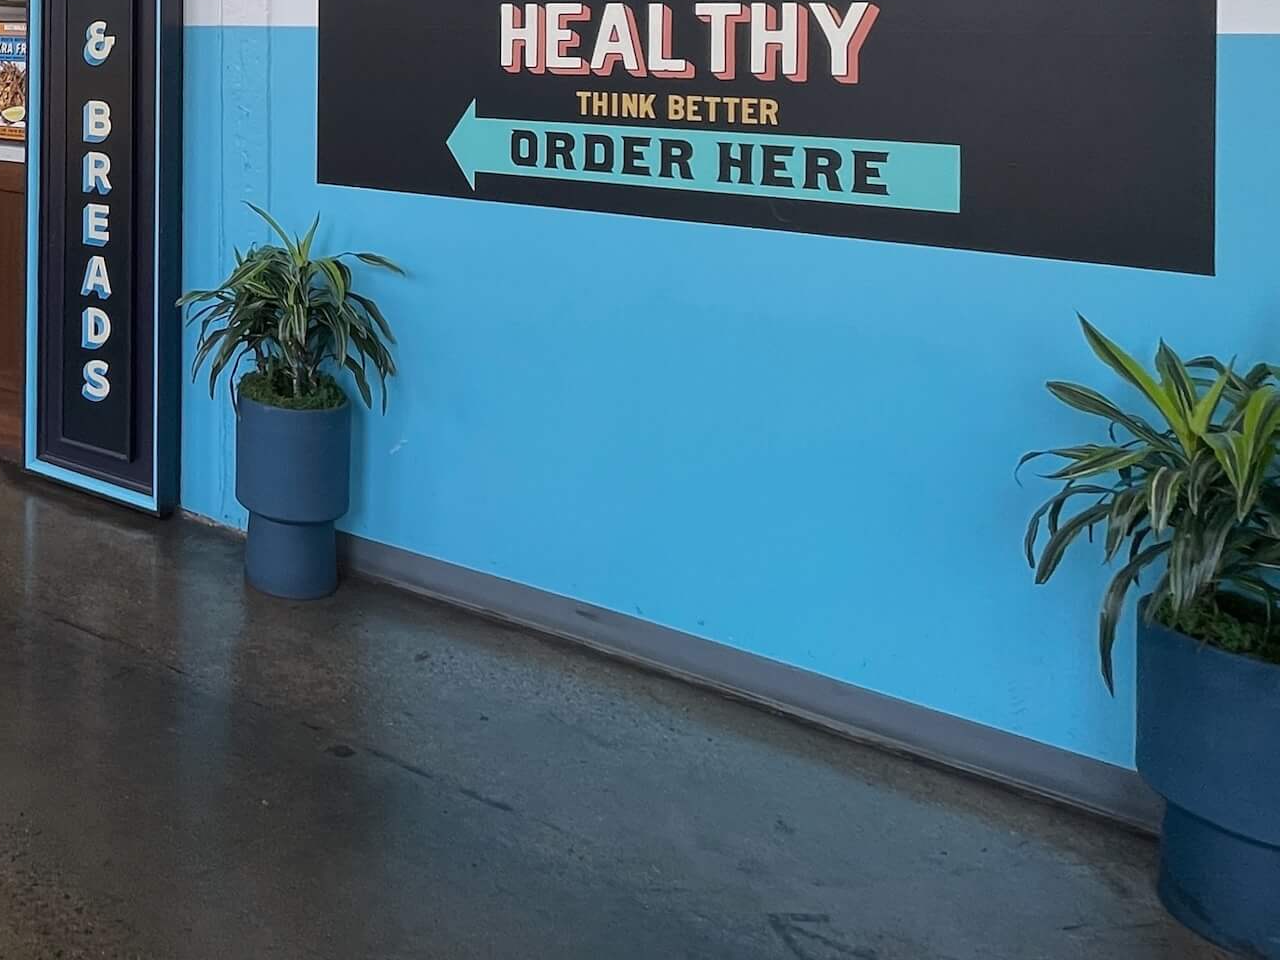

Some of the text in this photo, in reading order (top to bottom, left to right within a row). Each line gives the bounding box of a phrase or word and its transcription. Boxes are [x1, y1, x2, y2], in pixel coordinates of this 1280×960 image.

[83, 19, 116, 66] &
[500, 2, 880, 84] HEALTHY
[576, 90, 780, 126] THINK BETTER
[510, 128, 891, 196] ORDER HERE
[80, 99, 113, 403] BREADS
